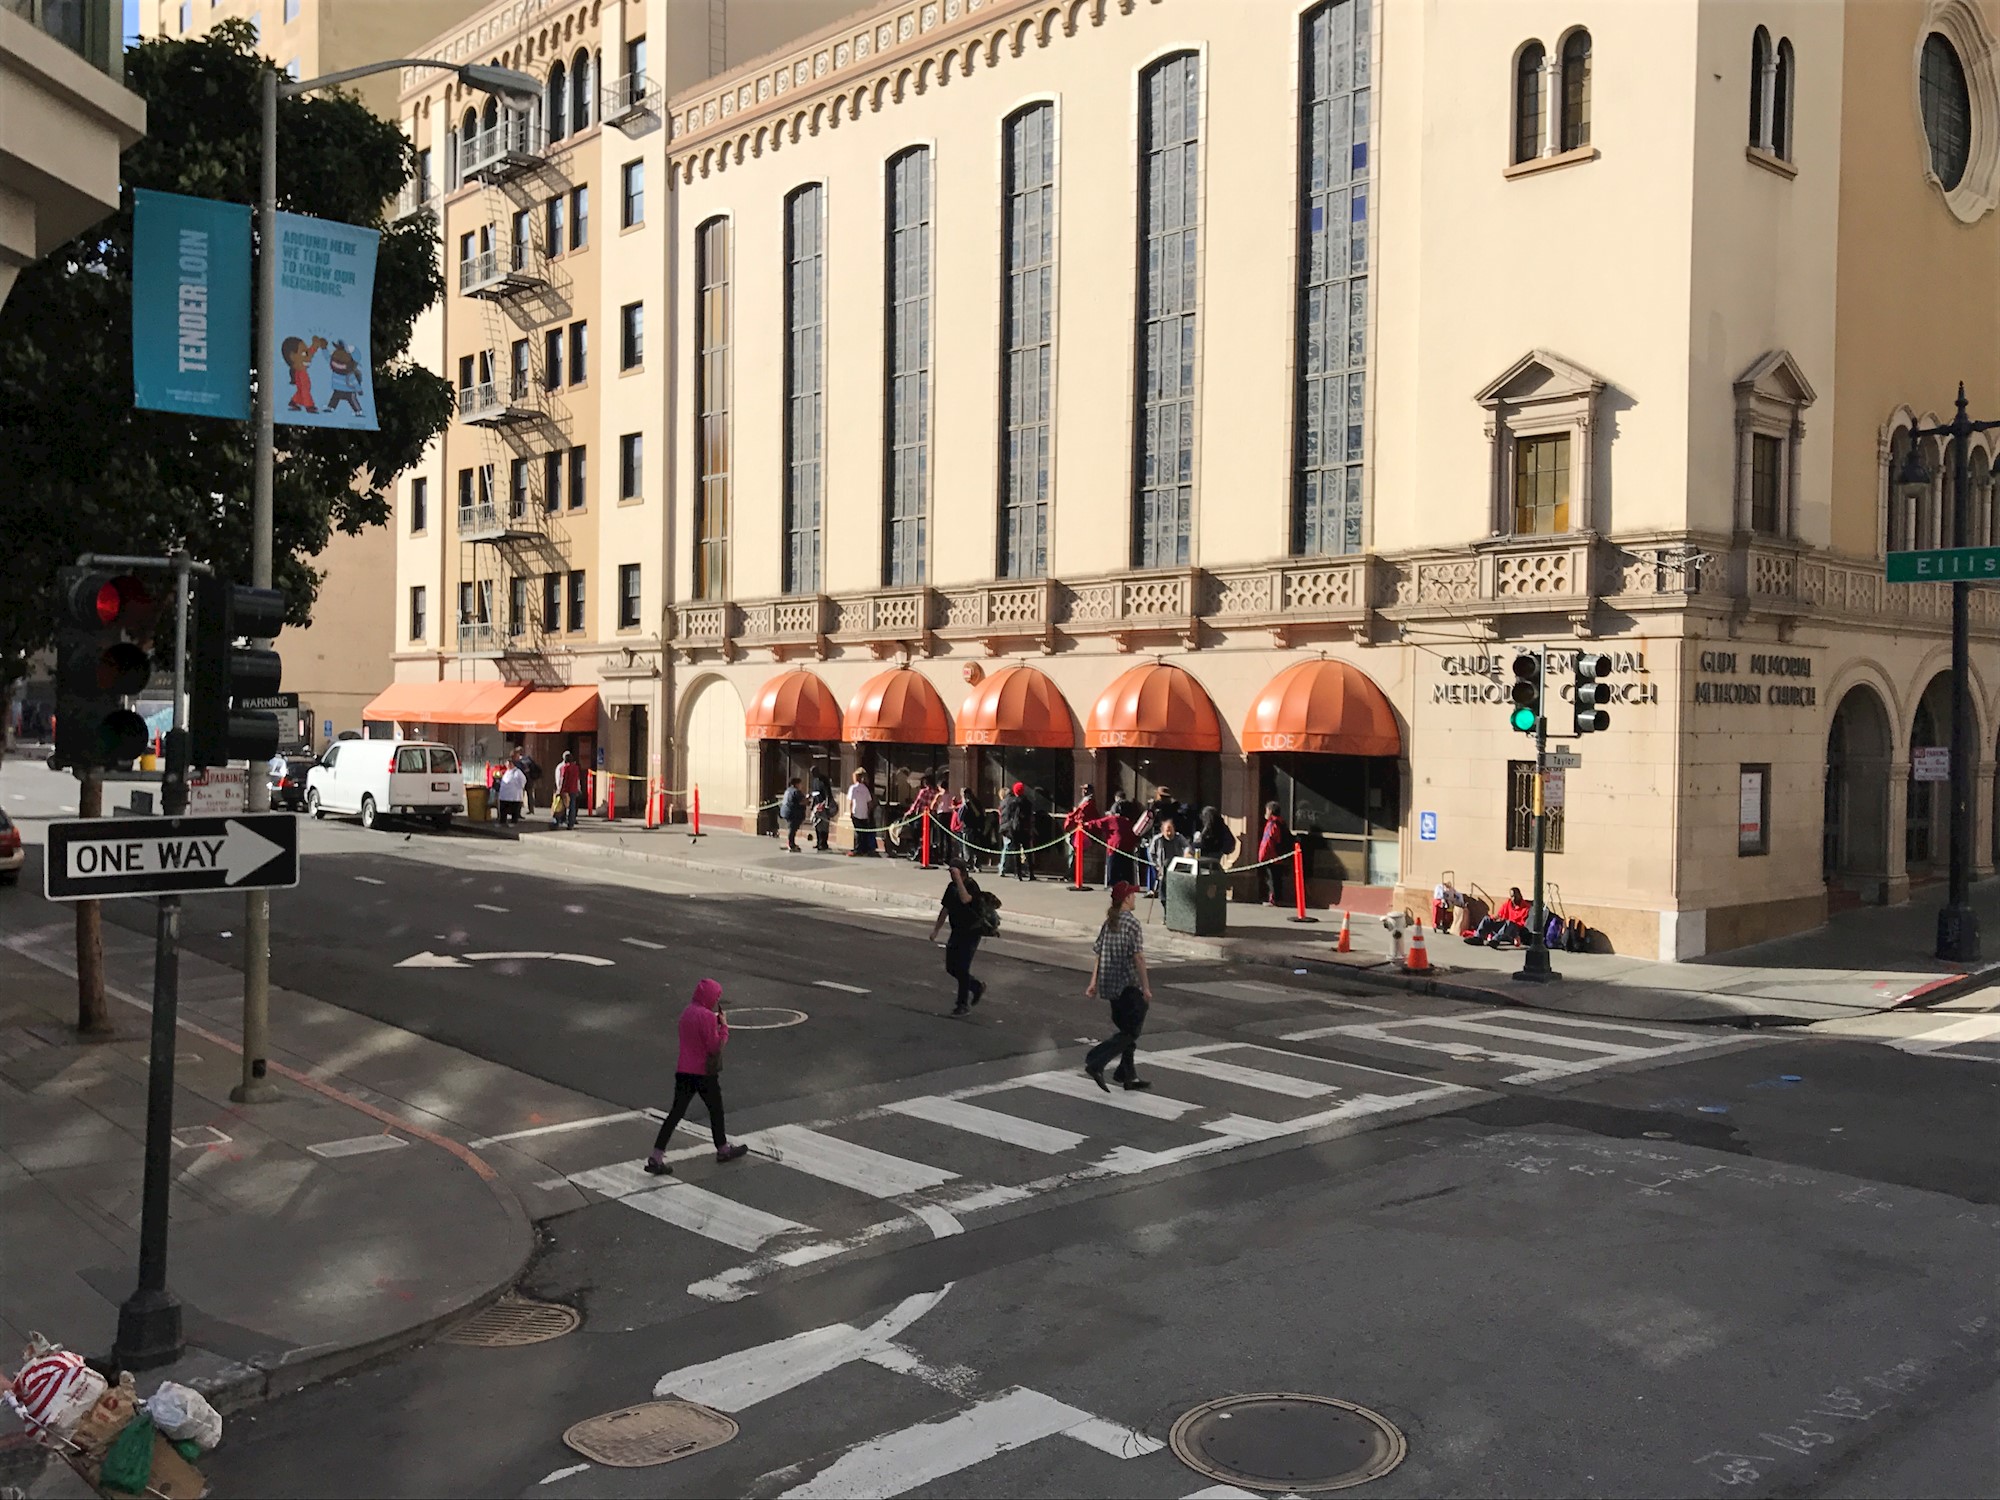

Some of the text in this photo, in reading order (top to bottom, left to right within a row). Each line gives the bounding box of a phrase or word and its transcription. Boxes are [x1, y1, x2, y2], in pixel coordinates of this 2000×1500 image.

[283, 231, 357, 256] AROUND HERE
[282, 245, 330, 265] WE TEND
[282, 260, 355, 285] TO KNOW OUR
[179, 229, 208, 373] TENDERLOIN
[1917, 556, 1996, 574] Ellis
[1441, 653, 1502, 676] GLIDE
[1701, 650, 1812, 678] GLIDE MEMORIAL
[243, 697, 289, 709] WARNING
[1696, 682, 1816, 706] METHODIST CHURCH
[850, 728, 871, 741] GLIDE
[965, 730, 989, 743] GLIDE
[1100, 732, 1127, 746] GLIDE
[1262, 733, 1295, 750] GLIDE
[1554, 756, 1575, 765] Taylor
[209, 772, 245, 784] PARKING
[76, 840, 225, 873] ONE WAY
